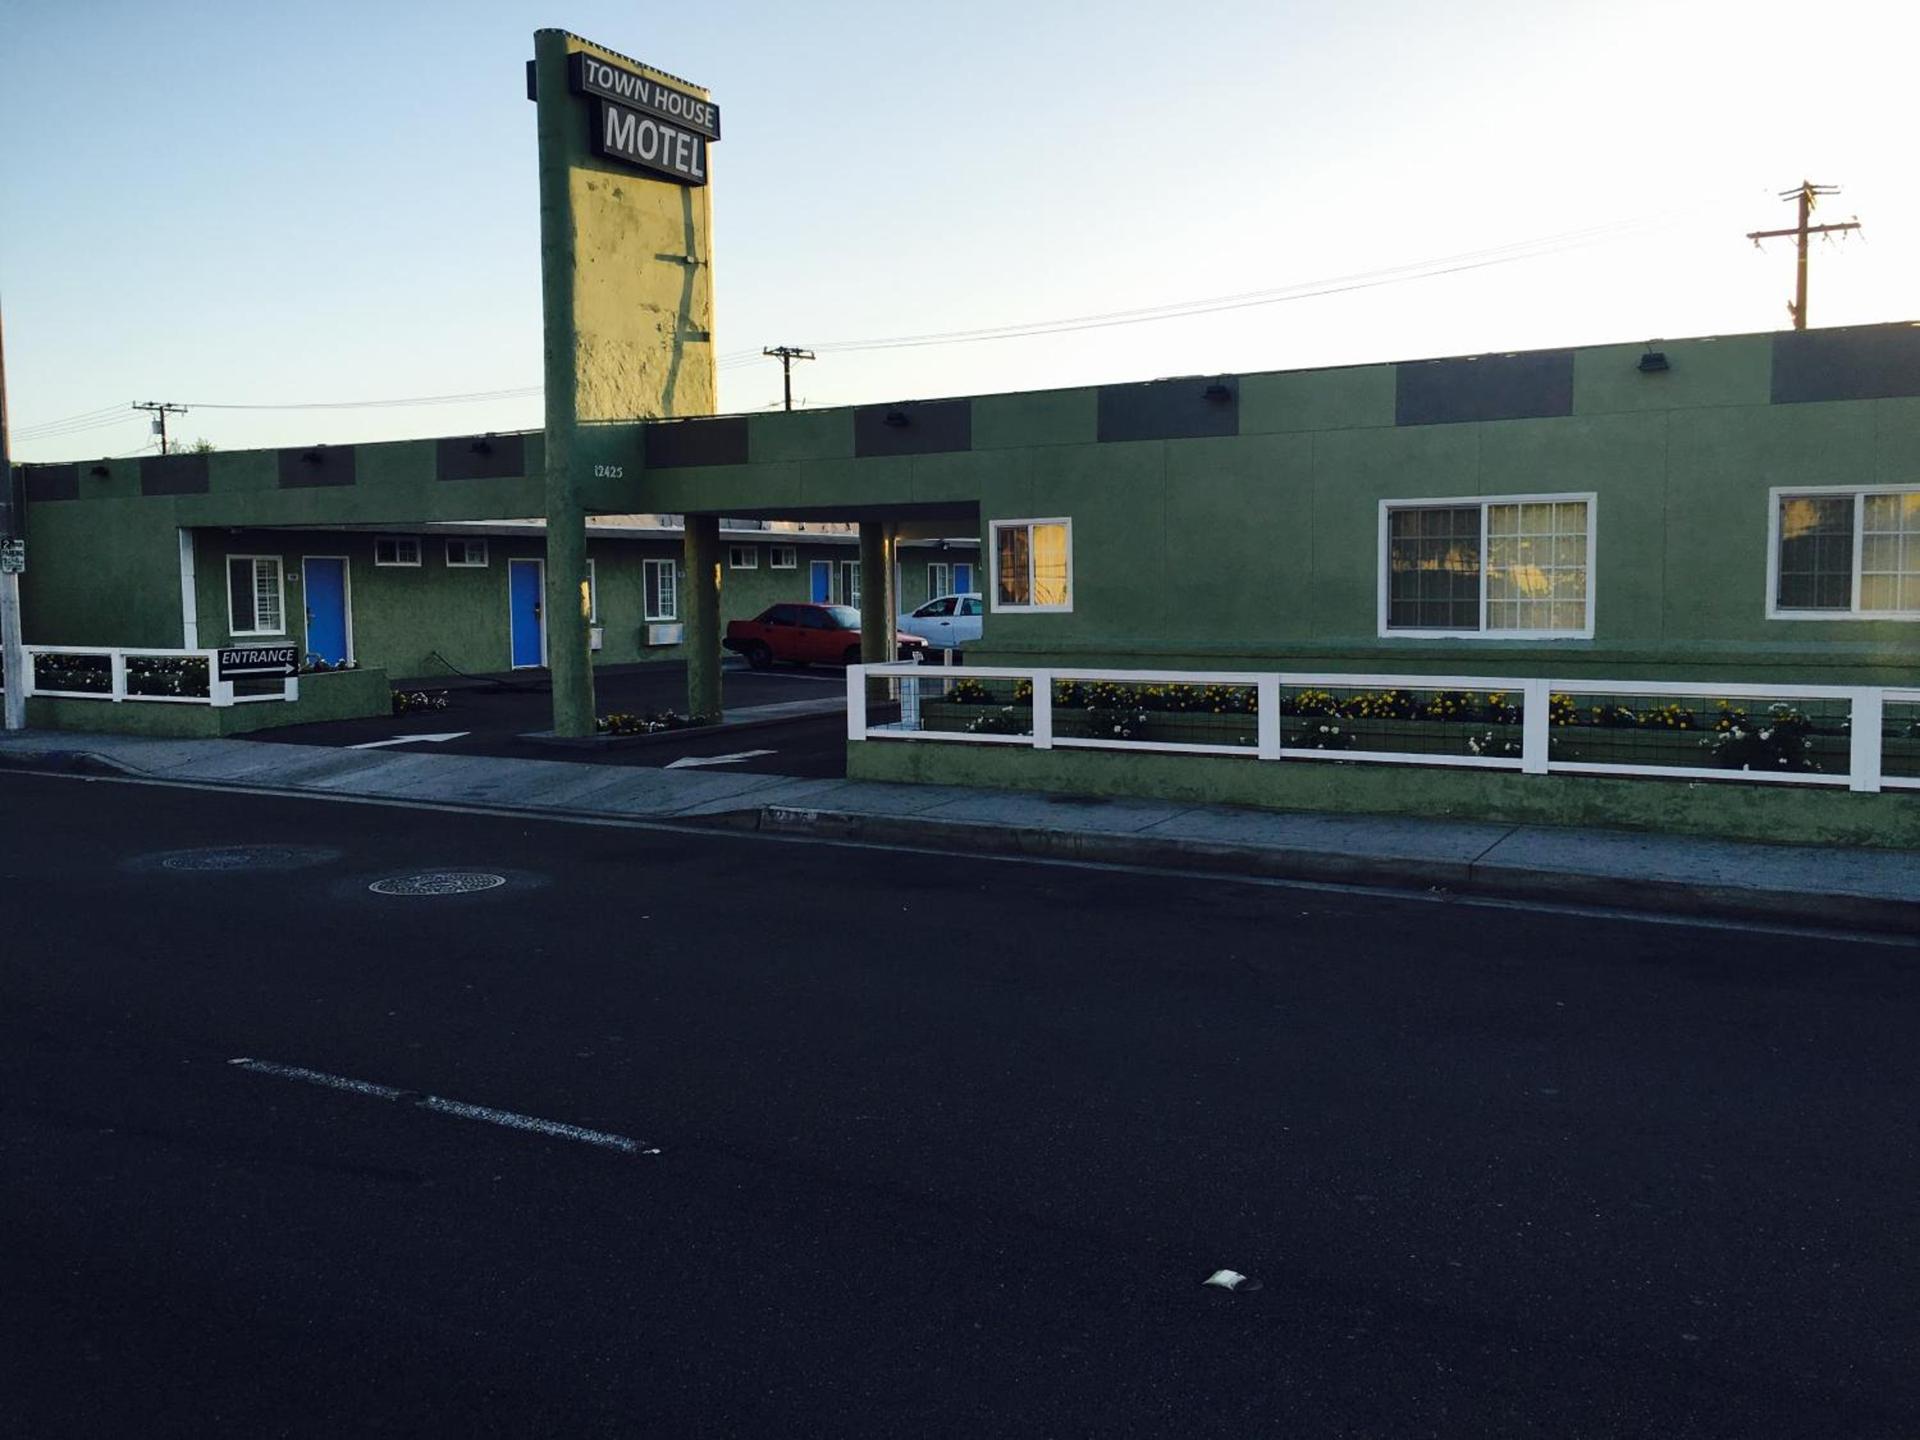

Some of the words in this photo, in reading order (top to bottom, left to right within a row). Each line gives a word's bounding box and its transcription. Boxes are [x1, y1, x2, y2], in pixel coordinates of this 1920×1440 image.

[587, 60, 649, 103] TOWN
[654, 87, 713, 127] HOUSE
[606, 107, 703, 177] MOTEL
[594, 465, 623, 478] 12425
[222, 650, 294, 664] ENTRANCE
